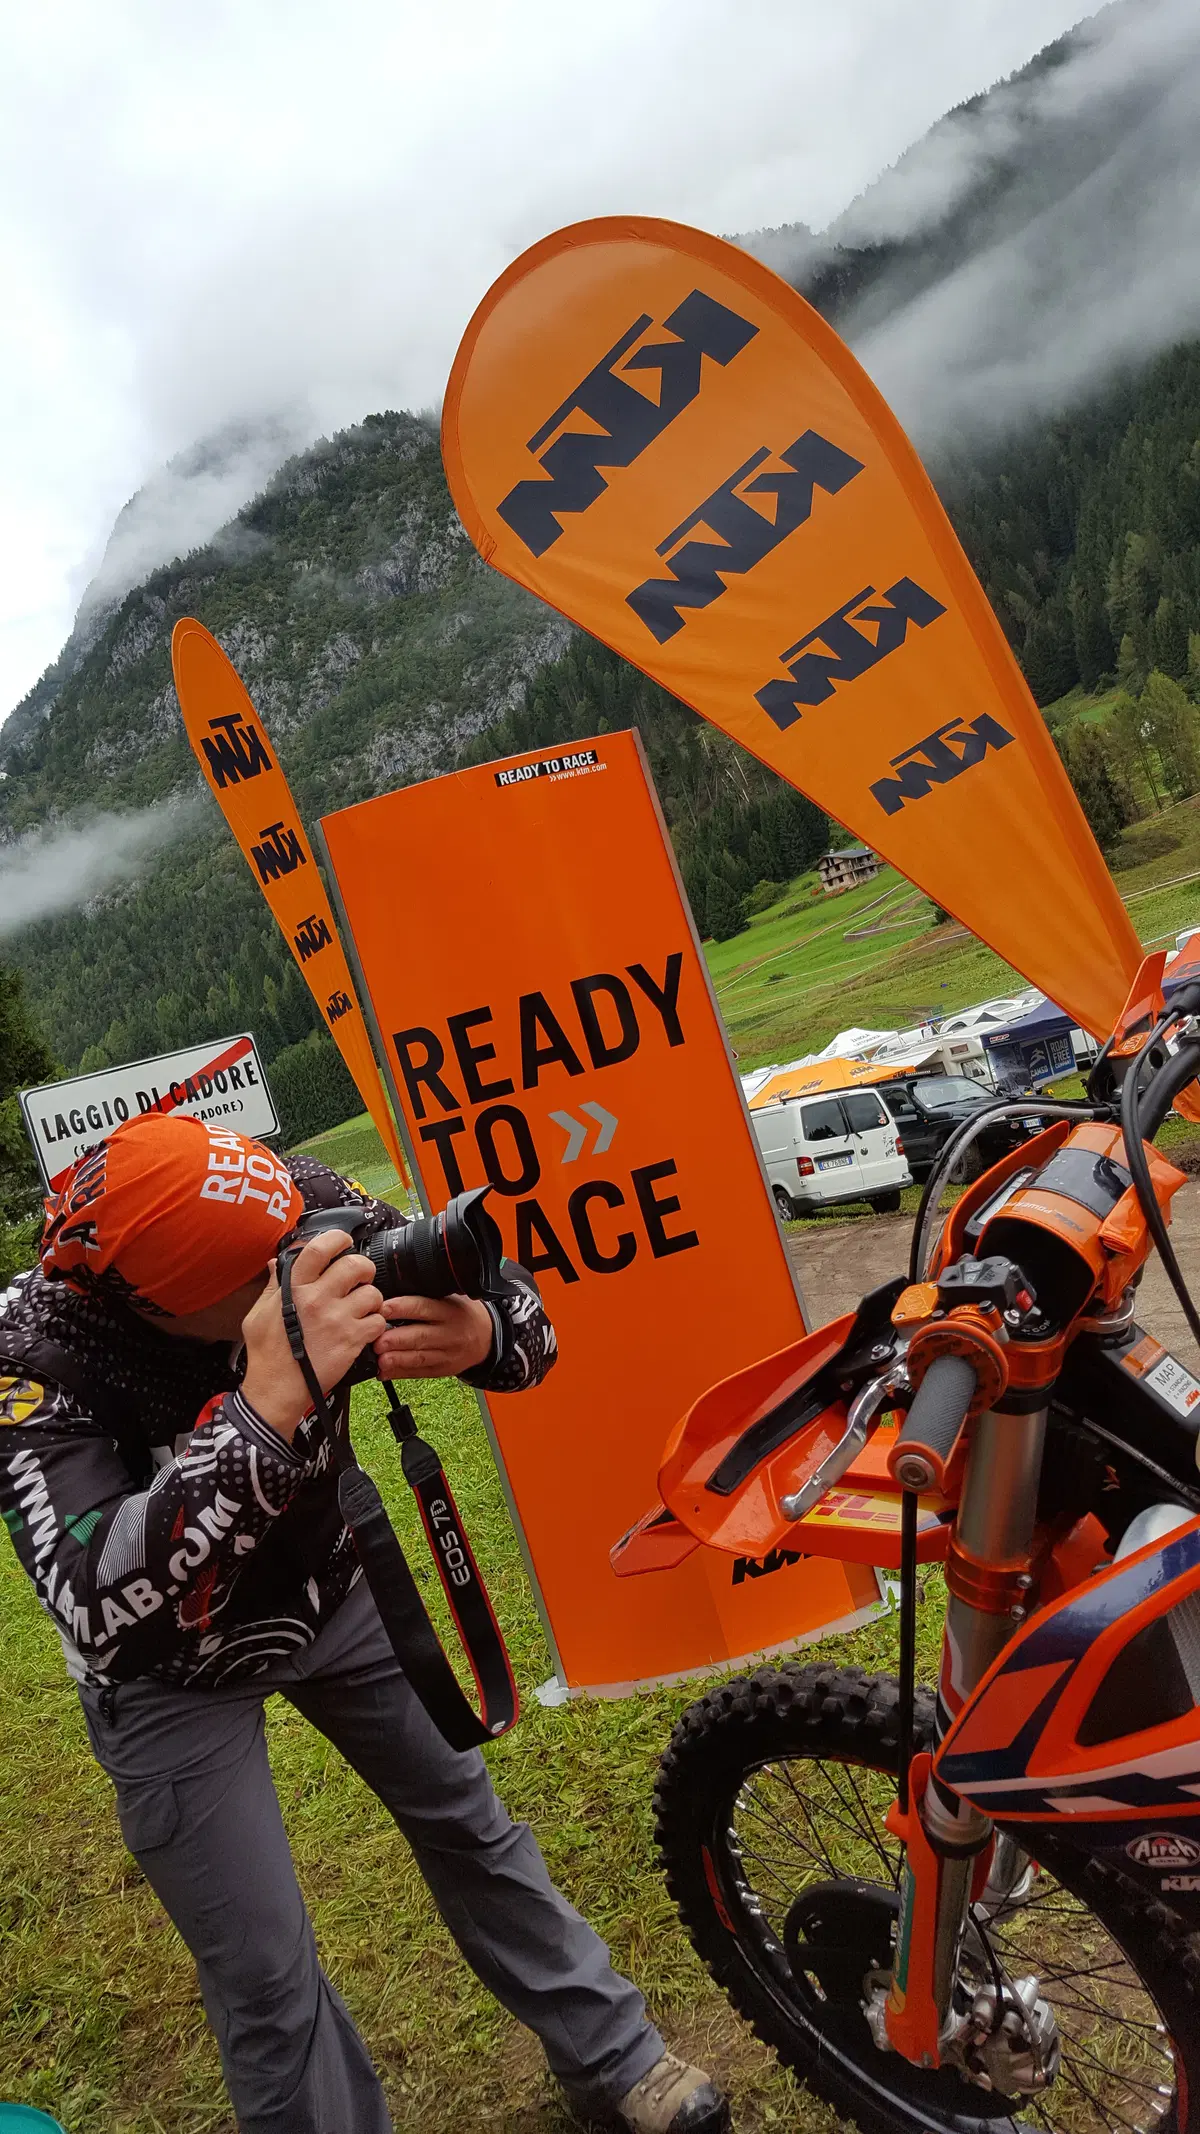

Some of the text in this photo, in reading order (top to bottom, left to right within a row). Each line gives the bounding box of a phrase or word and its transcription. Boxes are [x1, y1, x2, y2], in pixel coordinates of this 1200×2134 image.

[498, 751, 595, 786] READY TO RACE
[557, 763, 607, 781] www.ktm.com
[392, 952, 686, 1120] READY
[1050, 1038, 1069, 1052] ROAD
[1052, 1048, 1071, 1063] FREE
[40, 1061, 260, 1143] LAGGIO DI CADORE
[200, 1122, 245, 1203] READ
[237, 1154, 274, 1205] TO
[418, 1104, 541, 1200] TO
[266, 1150, 292, 1222] RA
[514, 1158, 700, 1284] ACE
[1155, 1364, 1176, 1386] MAP
[430, 1499, 471, 1586] EOS 7D
[1134, 1839, 1198, 1860] Airoh
